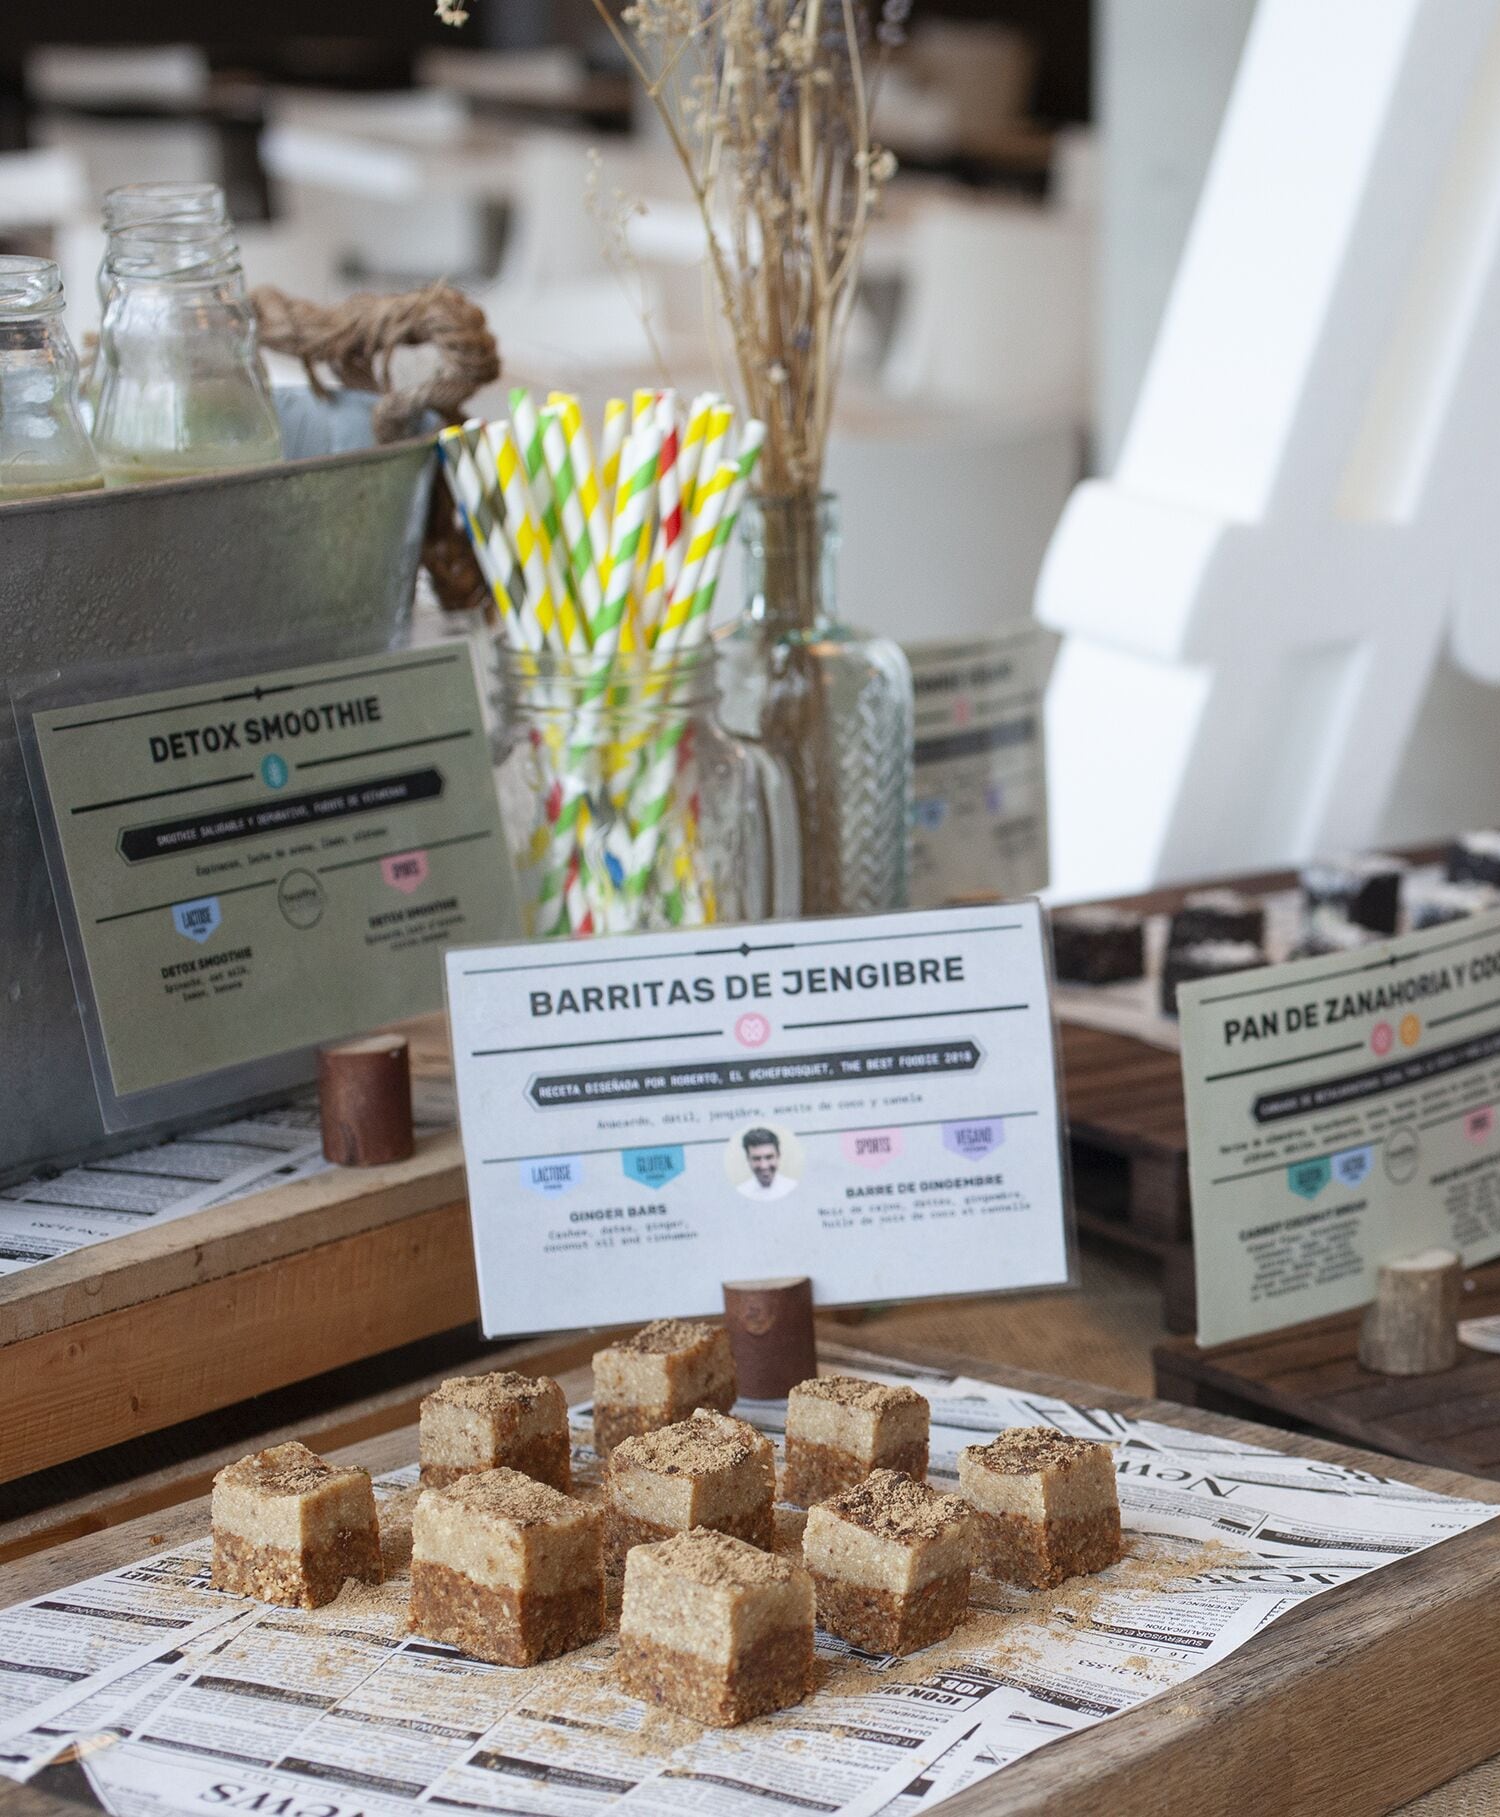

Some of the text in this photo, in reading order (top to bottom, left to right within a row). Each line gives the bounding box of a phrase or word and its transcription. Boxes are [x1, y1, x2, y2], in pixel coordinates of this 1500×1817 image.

[148, 695, 383, 764] DETOX SMOOTHIE
[155, 828, 197, 847] SMOOTHIE
[199, 819, 245, 839] SALUDABLE
[181, 906, 213, 929] LACTOSE
[161, 945, 254, 979] DETOX SMOOTHIE
[529, 956, 965, 1017] BARRITAS DE JENGIBRE
[1224, 1010, 1279, 1046] PAN
[1285, 1002, 1318, 1033] DE
[1324, 967, 1452, 1024] ZANAHORIA
[1453, 963, 1465, 988] Y
[538, 1083, 580, 1099] RECETA
[584, 1077, 640, 1096] DISEÑADA
[644, 1076, 666, 1089] POR
[670, 1072, 724, 1088] ROBERTO,
[729, 1069, 744, 1082] EL
[841, 1059, 861, 1073] THE
[866, 1056, 894, 1071] BEST
[899, 1052, 939, 1068] FOODIE
[596, 1115, 656, 1130] Anacardo,
[855, 1136, 891, 1155] SPORTS
[531, 1163, 571, 1184] LACTOSE
[635, 1153, 674, 1174] GLUTEN
[846, 1173, 1004, 1199] BARRE DE GINGEMBRE
[569, 1204, 667, 1223] GINGER BARS
[595, 1237, 614, 1248] oil
[621, 1234, 641, 1246] and
[1117, 1460, 1240, 1498] New
[1137, 1630, 1203, 1647] SUPERVISOR
[1144, 1622, 1217, 1638] QUALIFICATION:
[1107, 1640, 1188, 1660] 16 pages
[907, 1689, 961, 1705] ICON
[940, 1679, 985, 1696] JOB
[1052, 1692, 1109, 1711] DOCTORS
[878, 1708, 950, 1724] EXPERIENCE
[846, 1719, 933, 1737] QUALIFICATION
